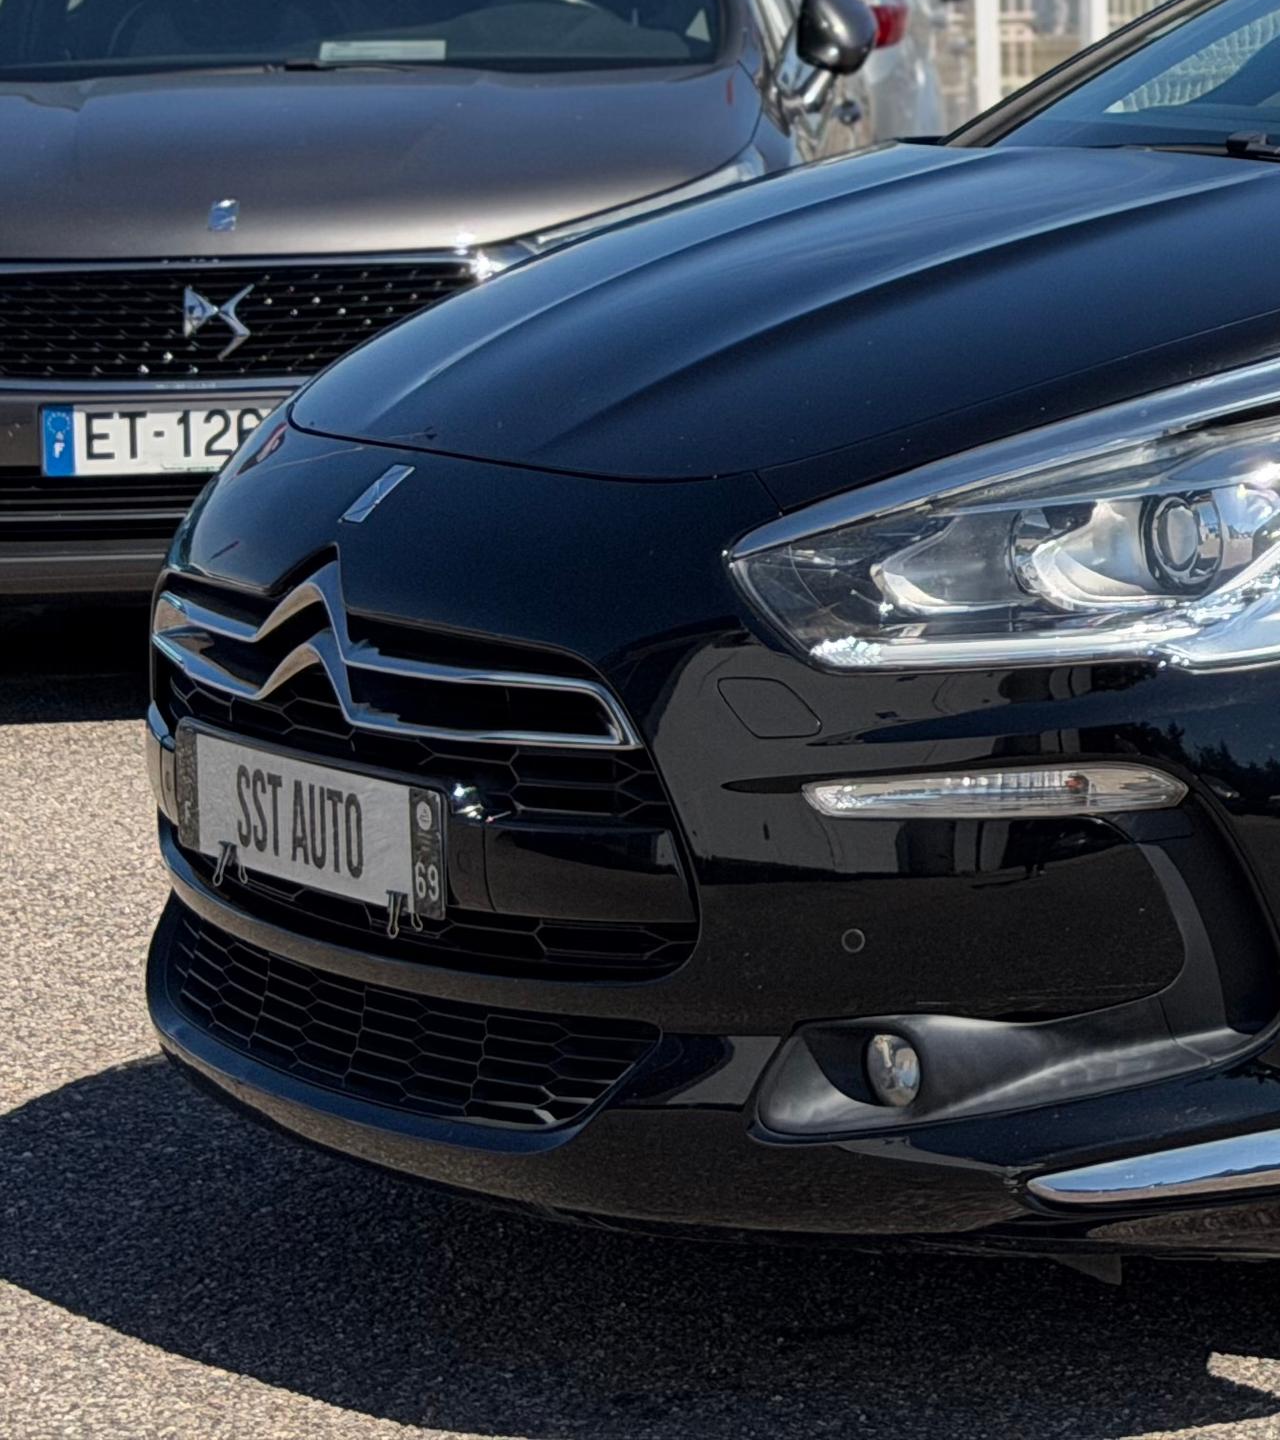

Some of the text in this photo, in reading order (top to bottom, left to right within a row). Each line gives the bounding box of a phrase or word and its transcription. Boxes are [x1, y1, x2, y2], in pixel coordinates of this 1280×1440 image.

[236, 764, 365, 880] SST AUTO
[414, 861, 440, 902] 69
